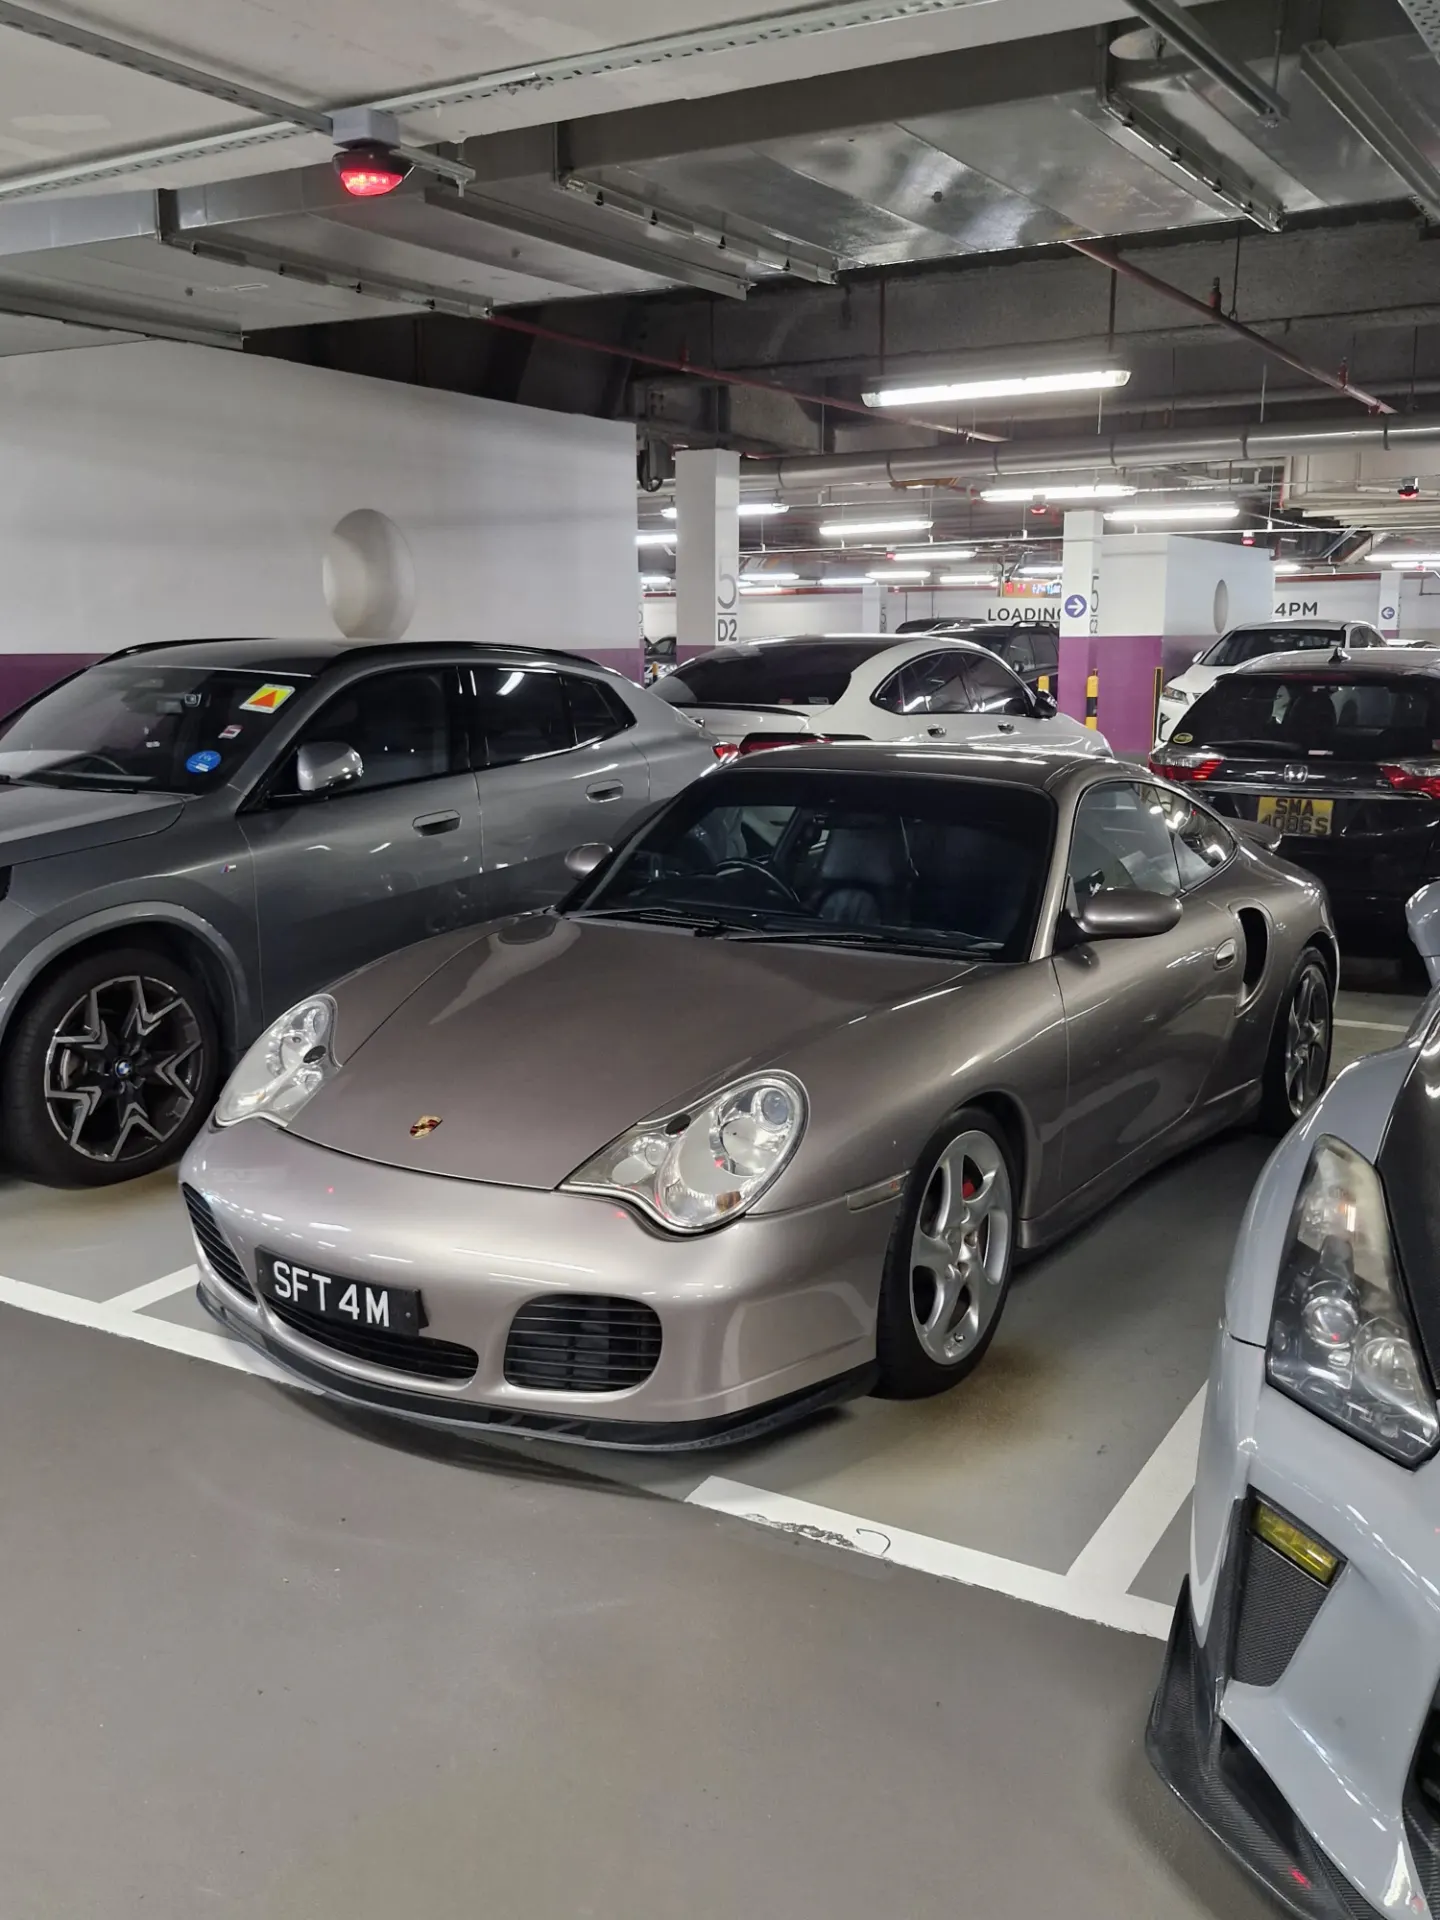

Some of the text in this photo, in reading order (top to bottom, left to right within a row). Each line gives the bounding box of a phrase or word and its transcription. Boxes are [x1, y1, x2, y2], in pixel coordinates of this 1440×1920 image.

[1275, 602, 1318, 616] 4PM
[717, 619, 737, 641] D2
[273, 1260, 390, 1328] SFT 4M
